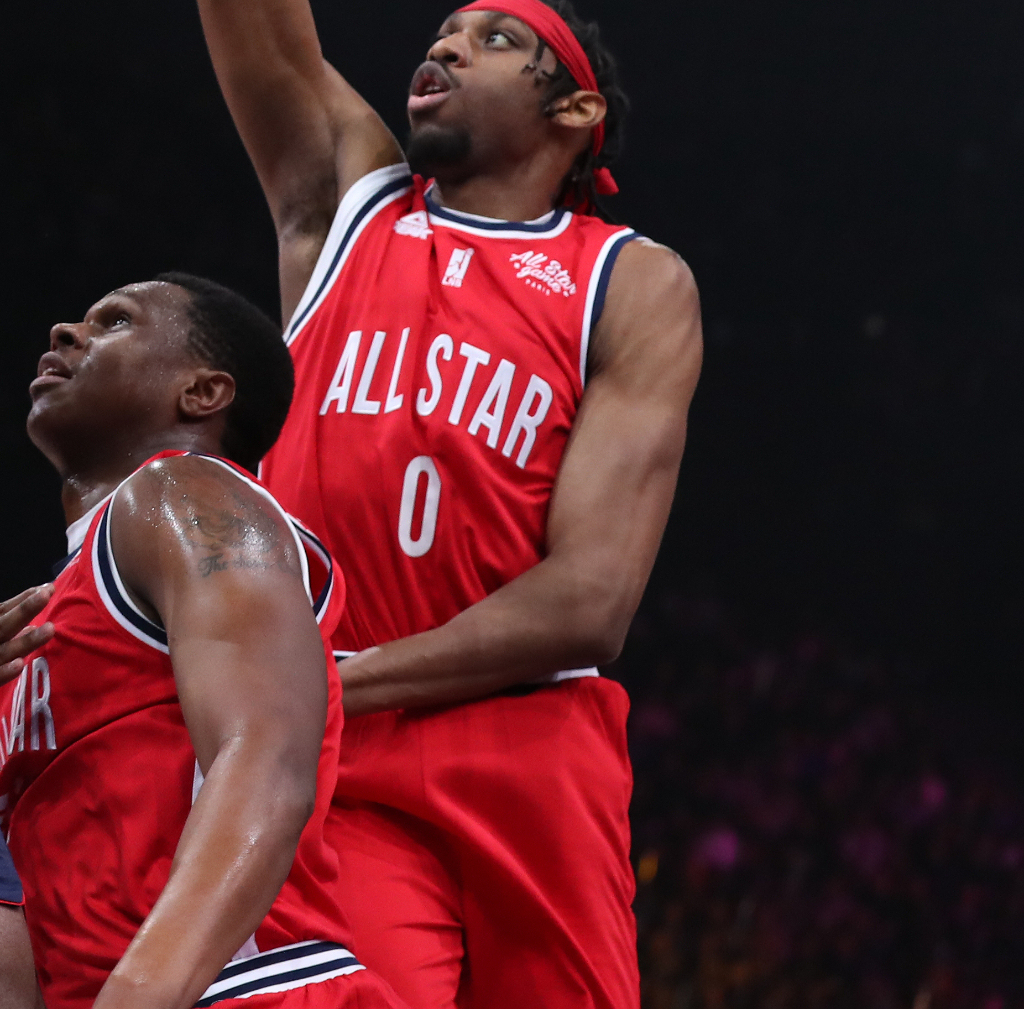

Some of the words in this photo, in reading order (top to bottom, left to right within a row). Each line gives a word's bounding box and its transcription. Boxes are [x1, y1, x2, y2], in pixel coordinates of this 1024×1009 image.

[318, 326, 411, 416] ALL
[415, 333, 554, 470] STAR
[397, 454, 442, 558] 0
